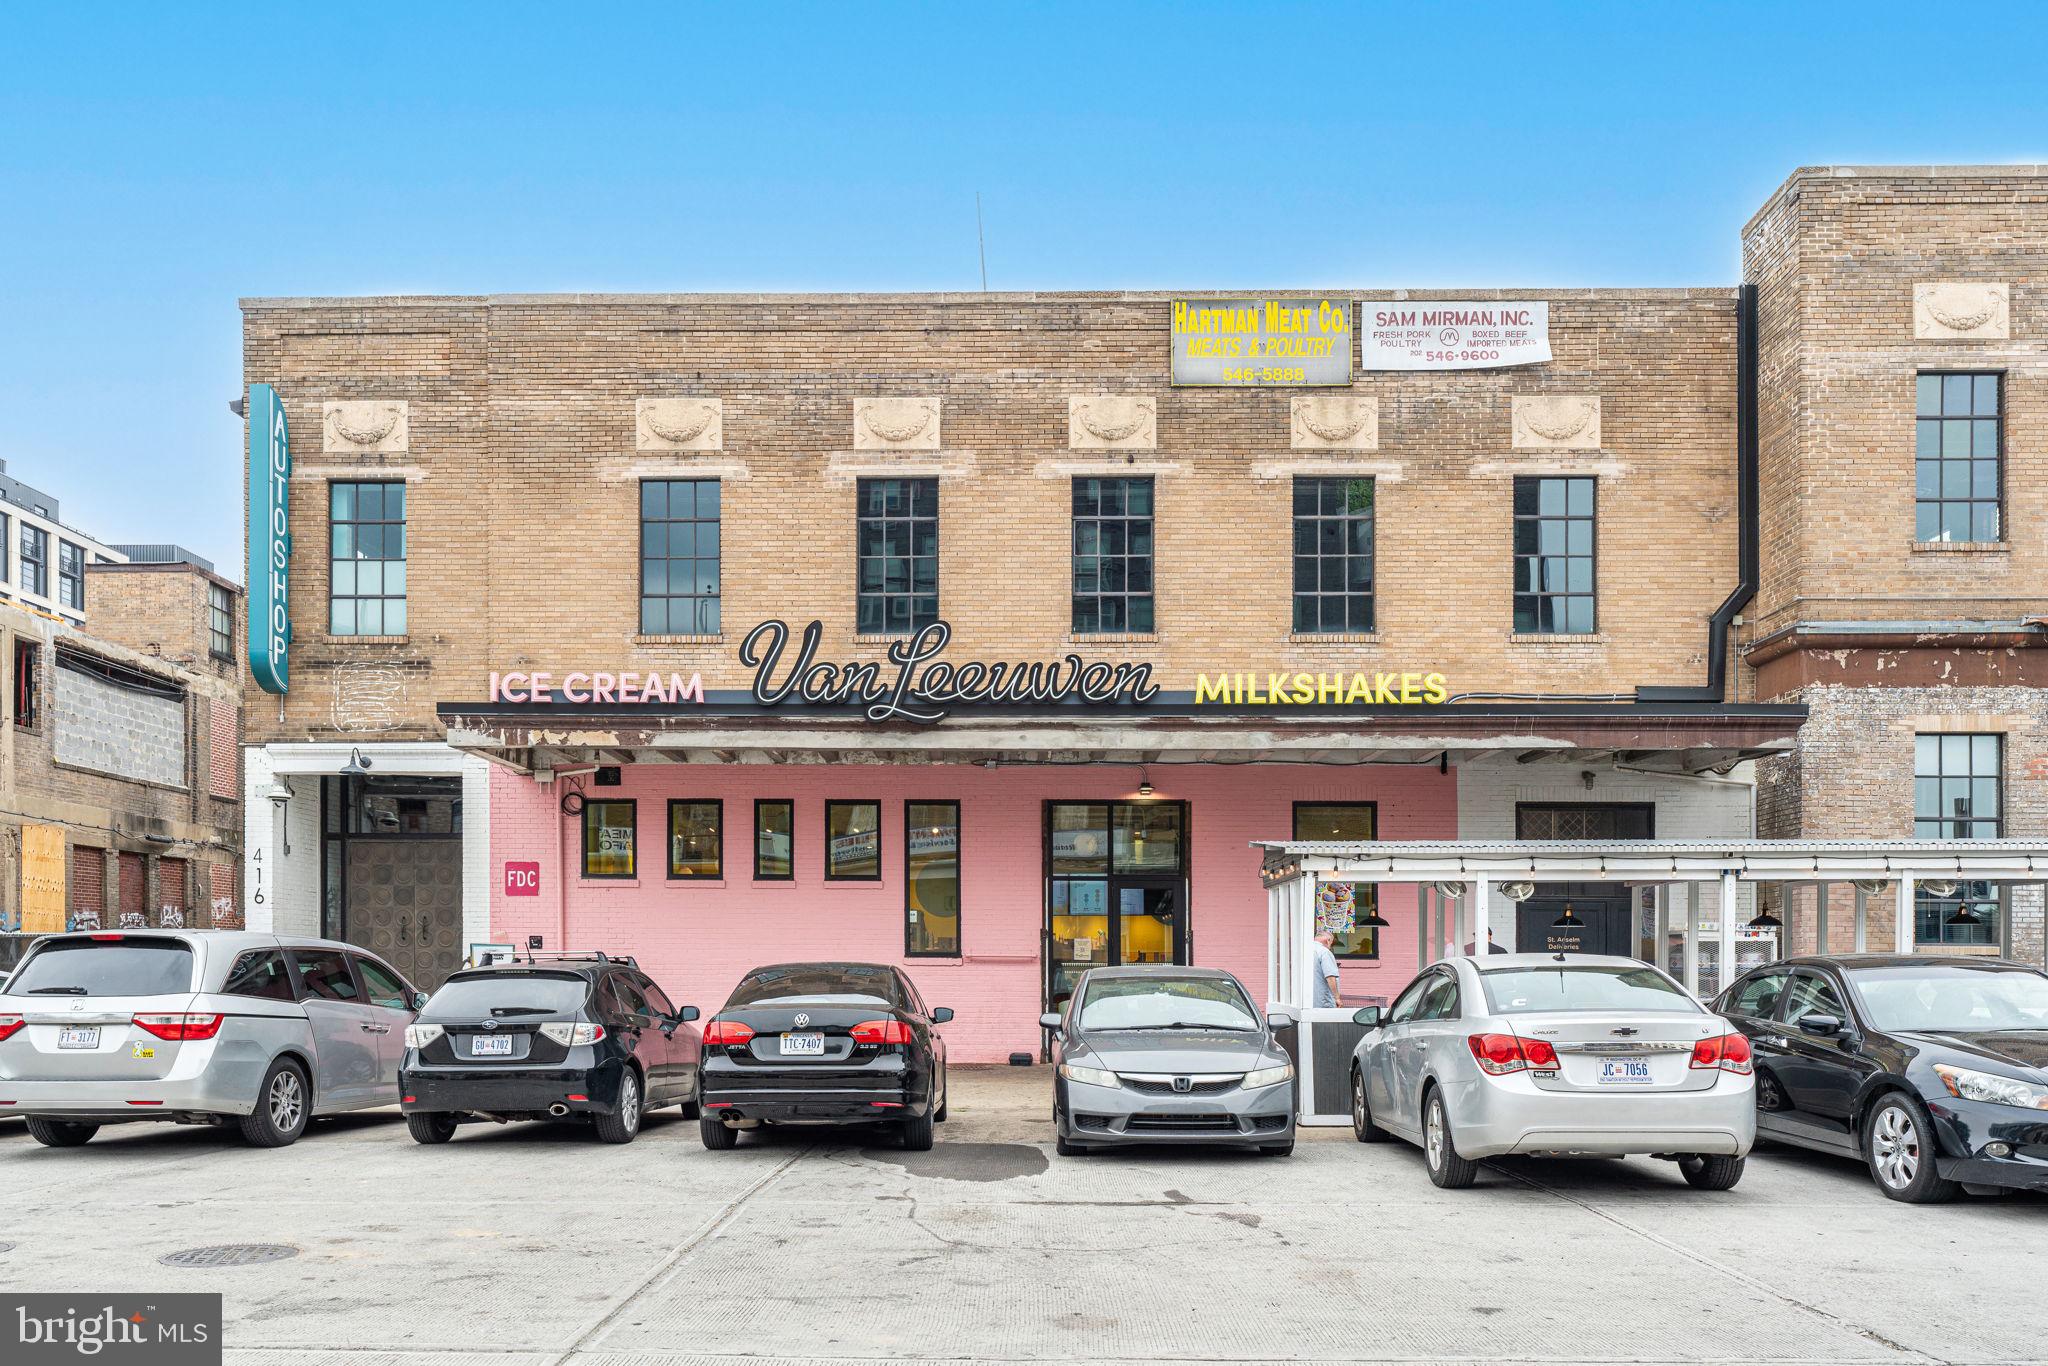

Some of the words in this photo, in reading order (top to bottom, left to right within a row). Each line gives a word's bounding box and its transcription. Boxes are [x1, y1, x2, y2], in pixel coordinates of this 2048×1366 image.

[1174, 301, 1259, 334] HARTMAN
[1265, 301, 1312, 334] MEAT
[1376, 311, 1416, 327] SAM
[1422, 310, 1497, 328] MIRMAN,
[1500, 310, 1534, 326] INC.
[1373, 331, 1403, 339] FRESH
[1472, 330, 1500, 338] BOXED
[1505, 330, 1528, 338] BEEF
[1187, 337, 1243, 357] MEATS
[1248, 337, 1261, 356] &
[1265, 336, 1336, 357] POULTRY
[1380, 339, 1422, 348] POULTRY
[1466, 339, 1507, 348] IMPORTED
[1509, 338, 1537, 347] MEATS
[1223, 367, 1305, 381] 546-5888
[273, 410, 287, 664] AUTOSHOP
[738, 619, 888, 706] Van
[865, 620, 1160, 724] Leeuwen
[489, 671, 552, 703] ICE
[562, 671, 705, 703] CREAM
[1195, 672, 1448, 704] MILKSHAKES
[253, 847, 265, 905] 416
[507, 870, 537, 887] FDC
[77, 1032, 96, 1043] 3177
[475, 1040, 485, 1050] GU
[490, 1039, 509, 1050] 4702
[1603, 1063, 1614, 1076] JC
[1624, 1063, 1648, 1076] 7056
